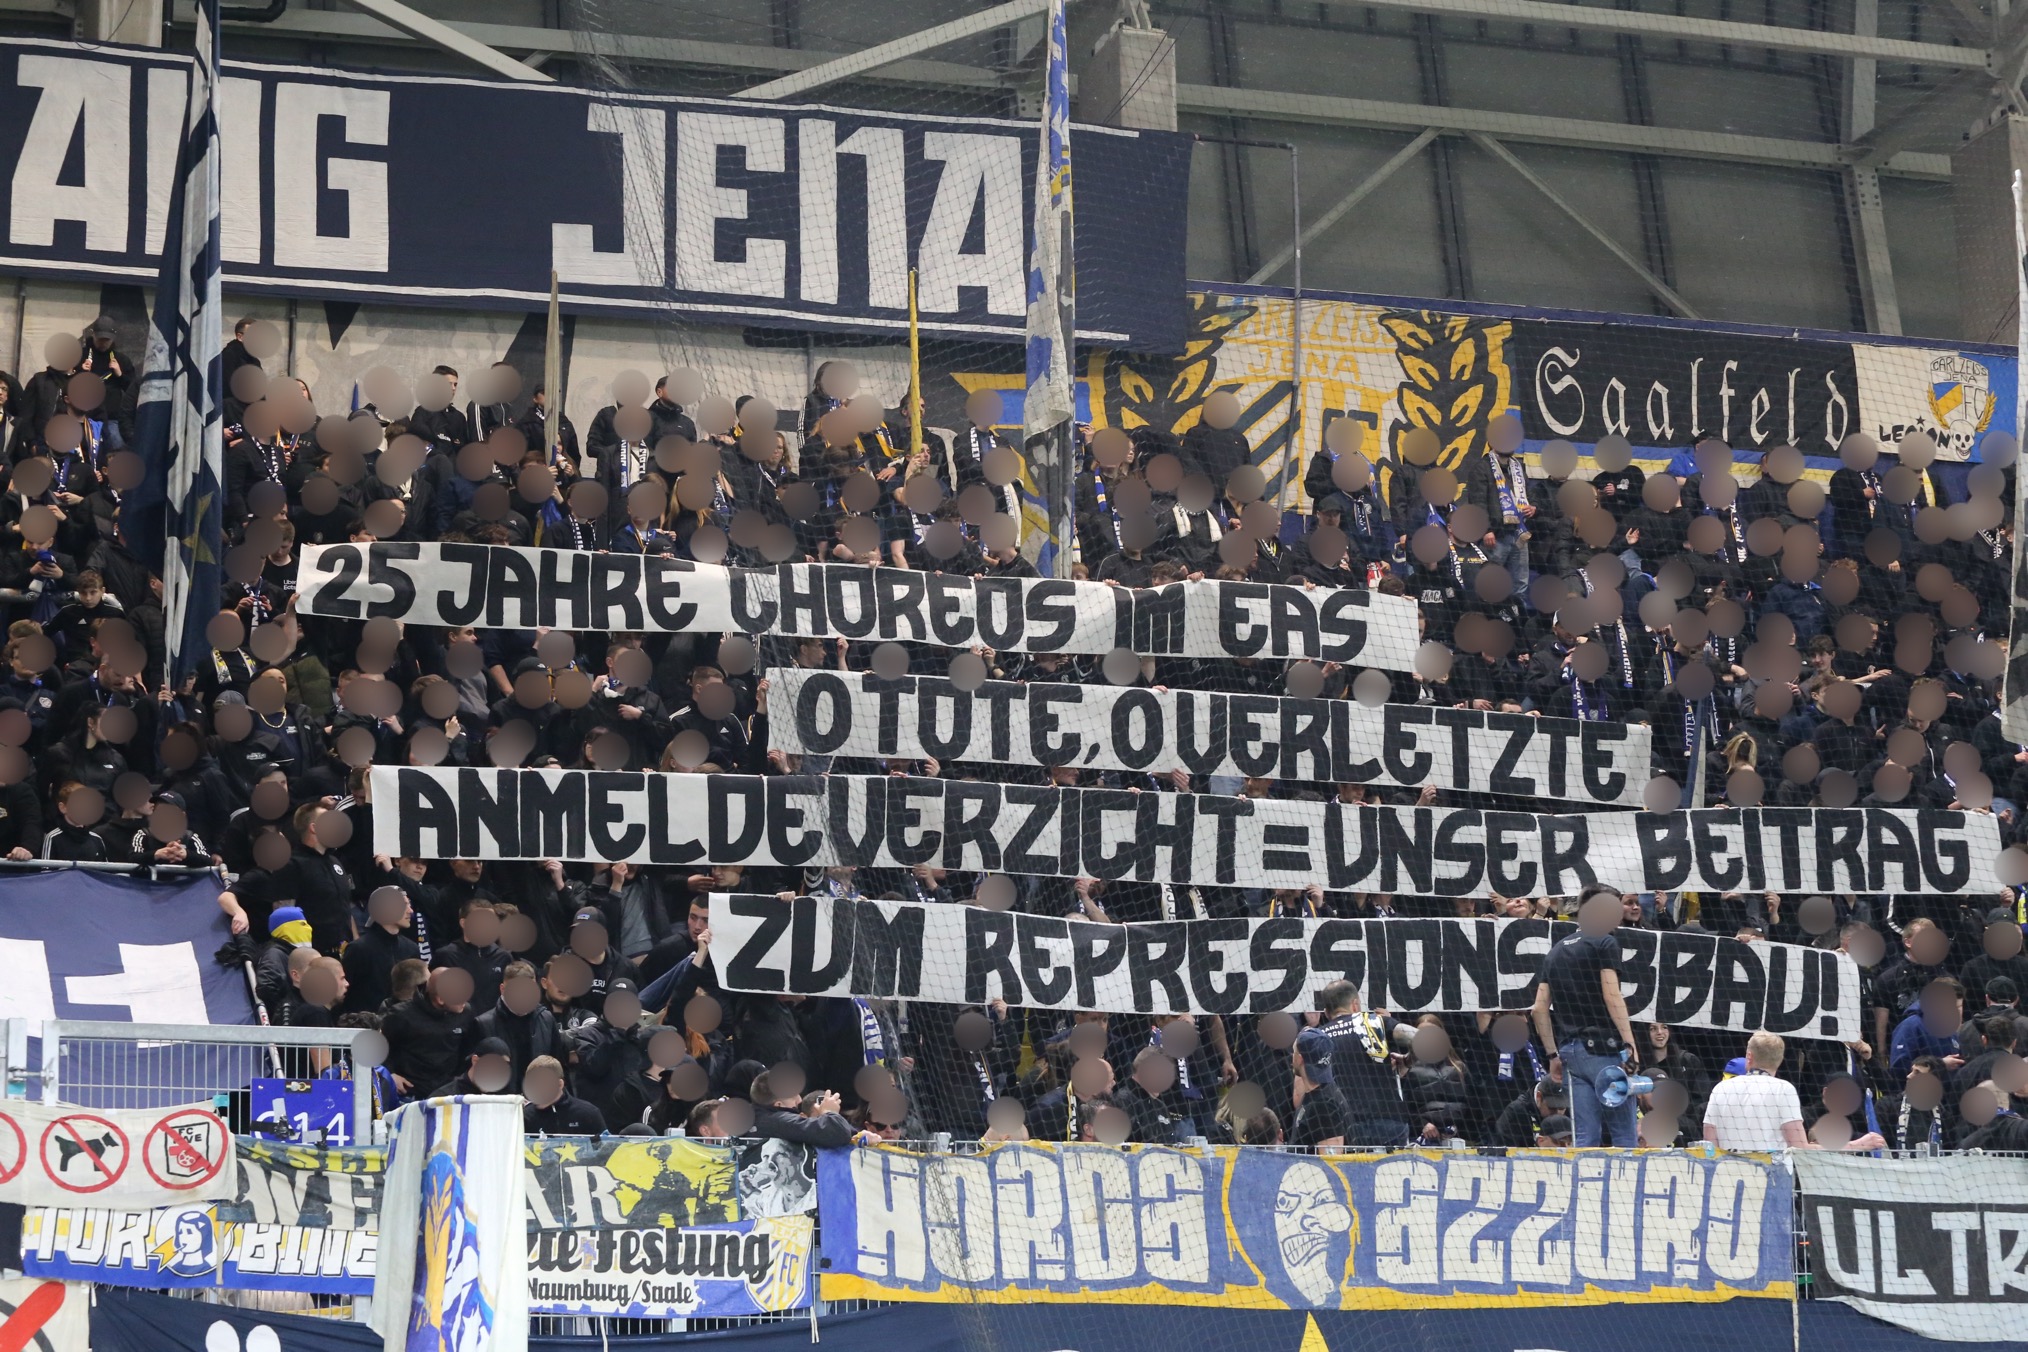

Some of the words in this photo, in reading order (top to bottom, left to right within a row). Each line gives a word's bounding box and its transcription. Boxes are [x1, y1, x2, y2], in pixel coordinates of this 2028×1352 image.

[551, 103, 1026, 317] JENA
[1248, 348, 1360, 382] JENA
[1943, 373, 1978, 383] JENA
[1535, 346, 1849, 451] Saalfeld
[1964, 385, 1988, 420] FC
[312, 543, 420, 620] 25
[437, 543, 698, 631] JAHRE
[1113, 583, 1186, 653] IM
[1219, 582, 1370, 662] EAS
[1642, 808, 1970, 895] BEITRAG
[726, 894, 925, 997] ZUM
[965, 908, 1840, 1037] REPRESSIONSBBAU!
[178, 1127, 193, 1135] FC
[779, 1252, 799, 1286] FC
